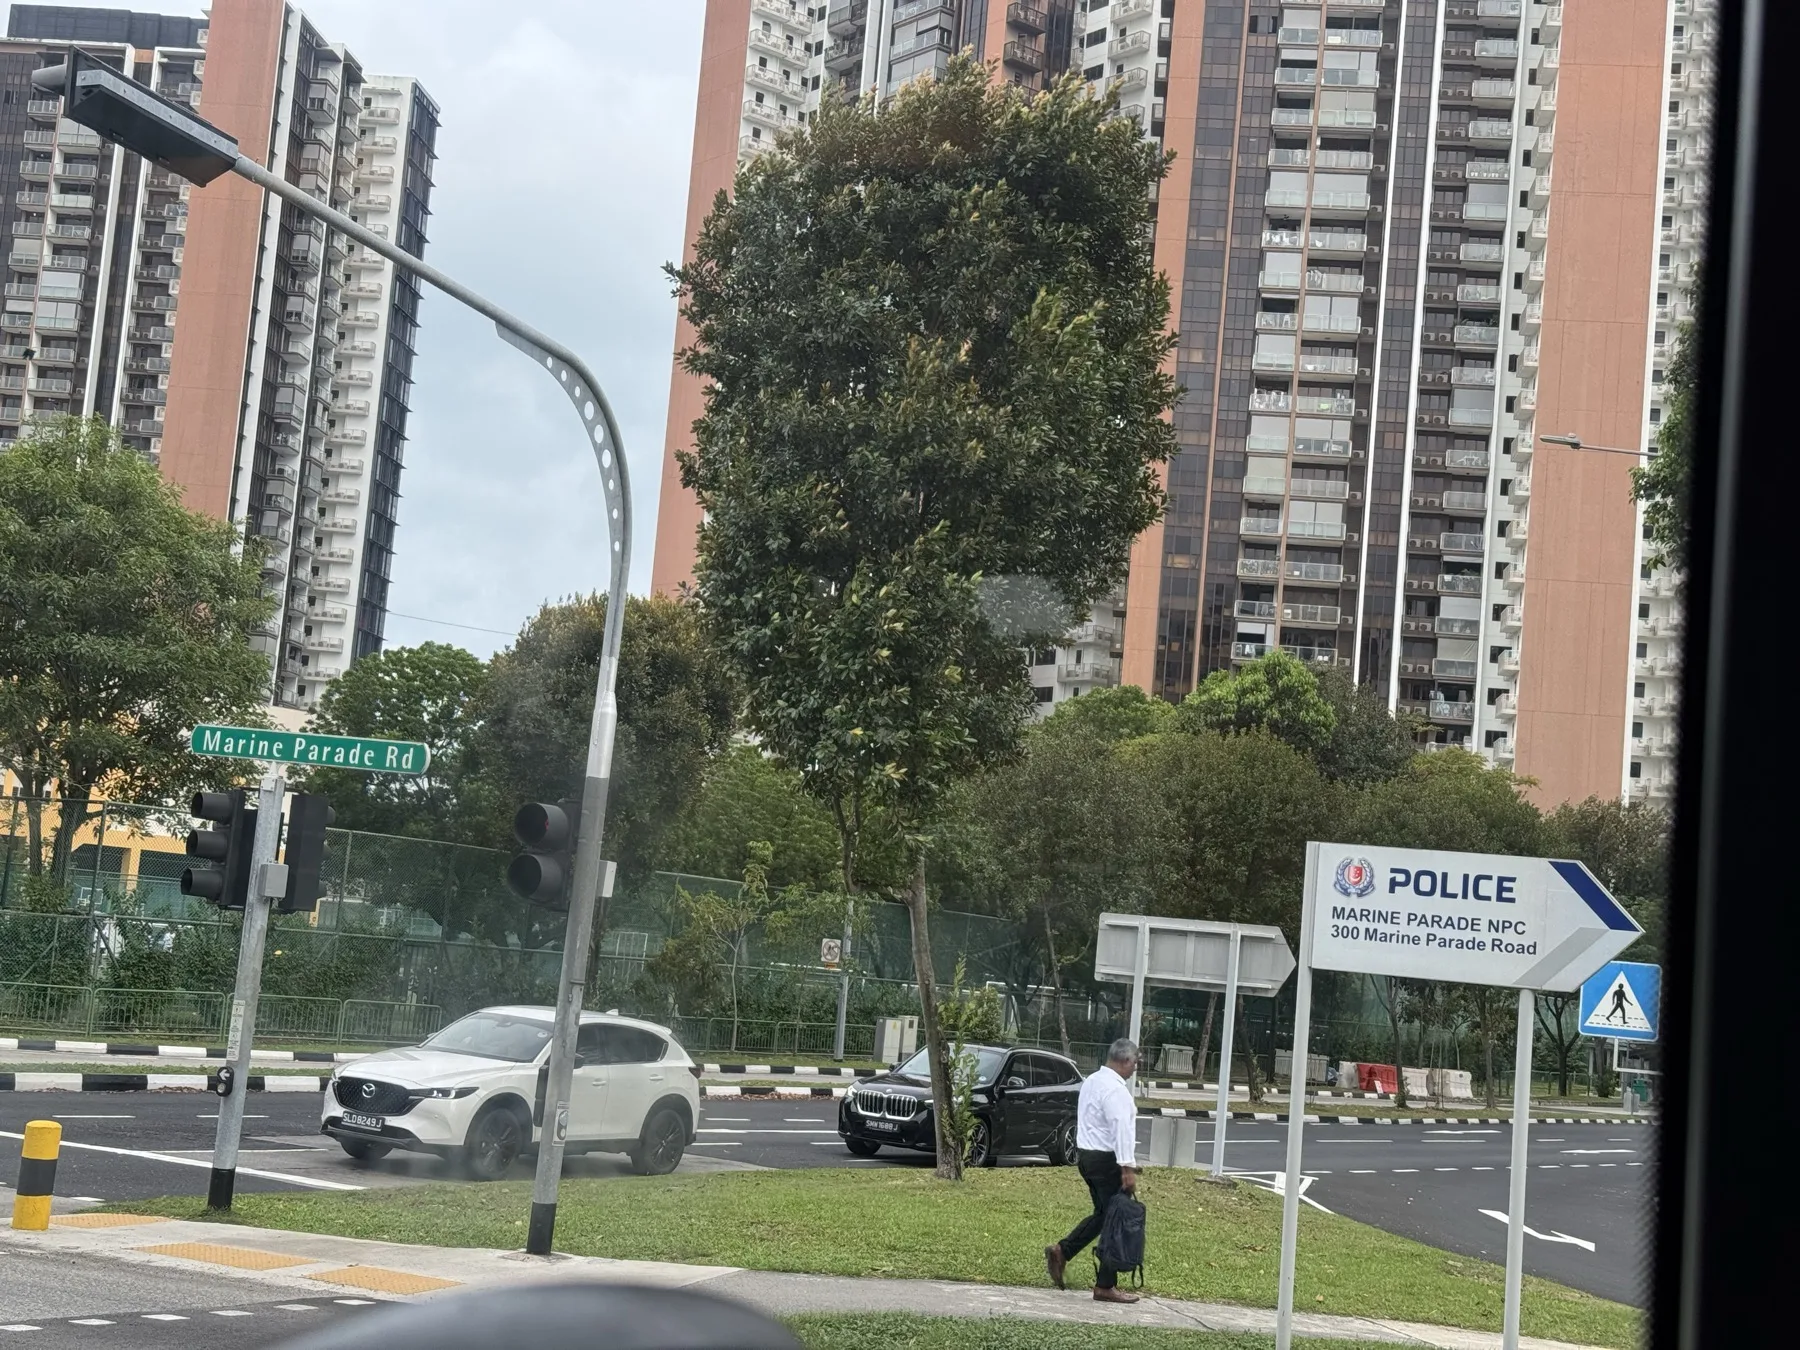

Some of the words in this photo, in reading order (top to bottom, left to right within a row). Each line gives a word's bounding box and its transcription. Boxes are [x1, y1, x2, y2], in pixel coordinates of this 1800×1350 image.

[203, 729, 283, 757] Marine
[293, 738, 375, 766] Parade
[385, 745, 414, 770] Rd
[1388, 867, 1517, 904] POLICE
[1331, 906, 1401, 925] MARINE
[1406, 912, 1481, 932] PARADE
[1488, 919, 1527, 936] NPC
[1330, 924, 1360, 940] 300
[1364, 927, 1421, 946] Marine
[1425, 933, 1486, 951] Parade
[1491, 938, 1537, 956] Road
